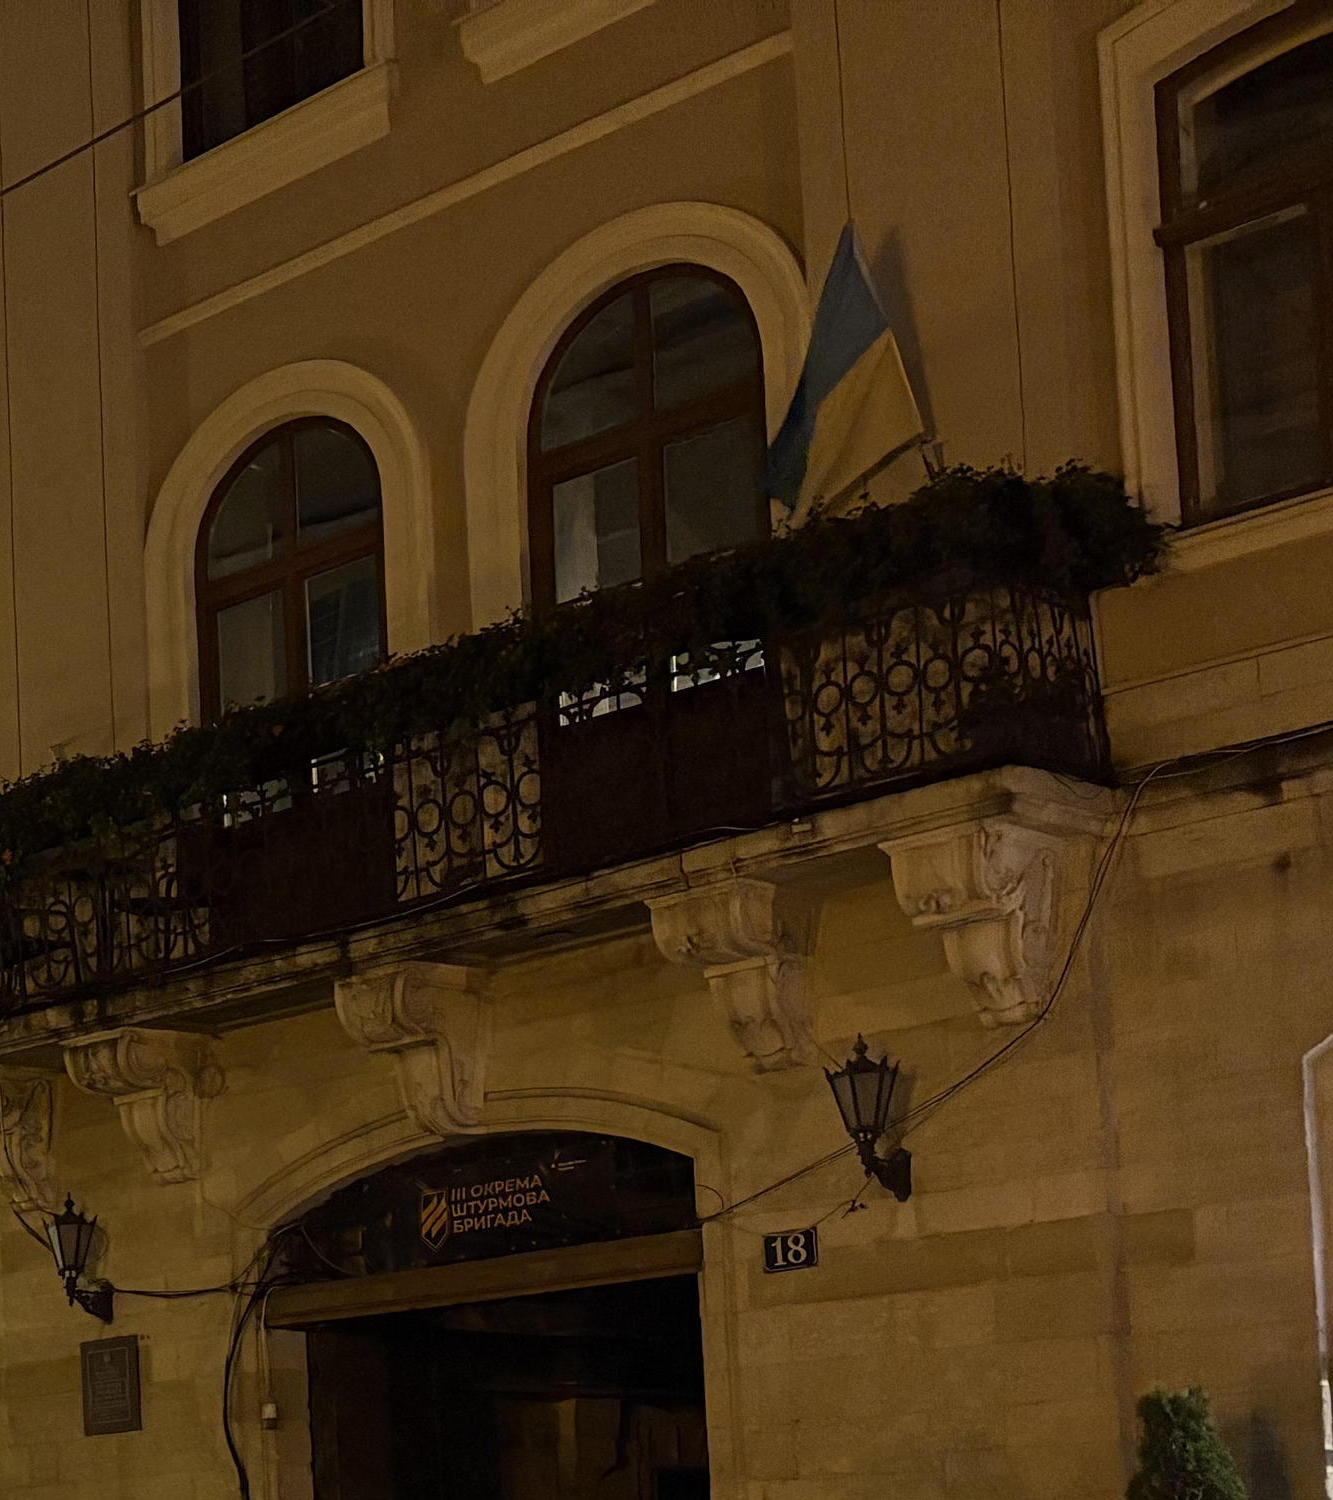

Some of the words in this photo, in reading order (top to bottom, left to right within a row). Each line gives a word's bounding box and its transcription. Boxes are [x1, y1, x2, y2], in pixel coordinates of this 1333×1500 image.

[470, 1174, 543, 1198] ОКРЕМА
[451, 1190, 551, 1218] ШТУРМОВА
[453, 1209, 532, 1234] БРИГАДА
[771, 1233, 807, 1266] 18
